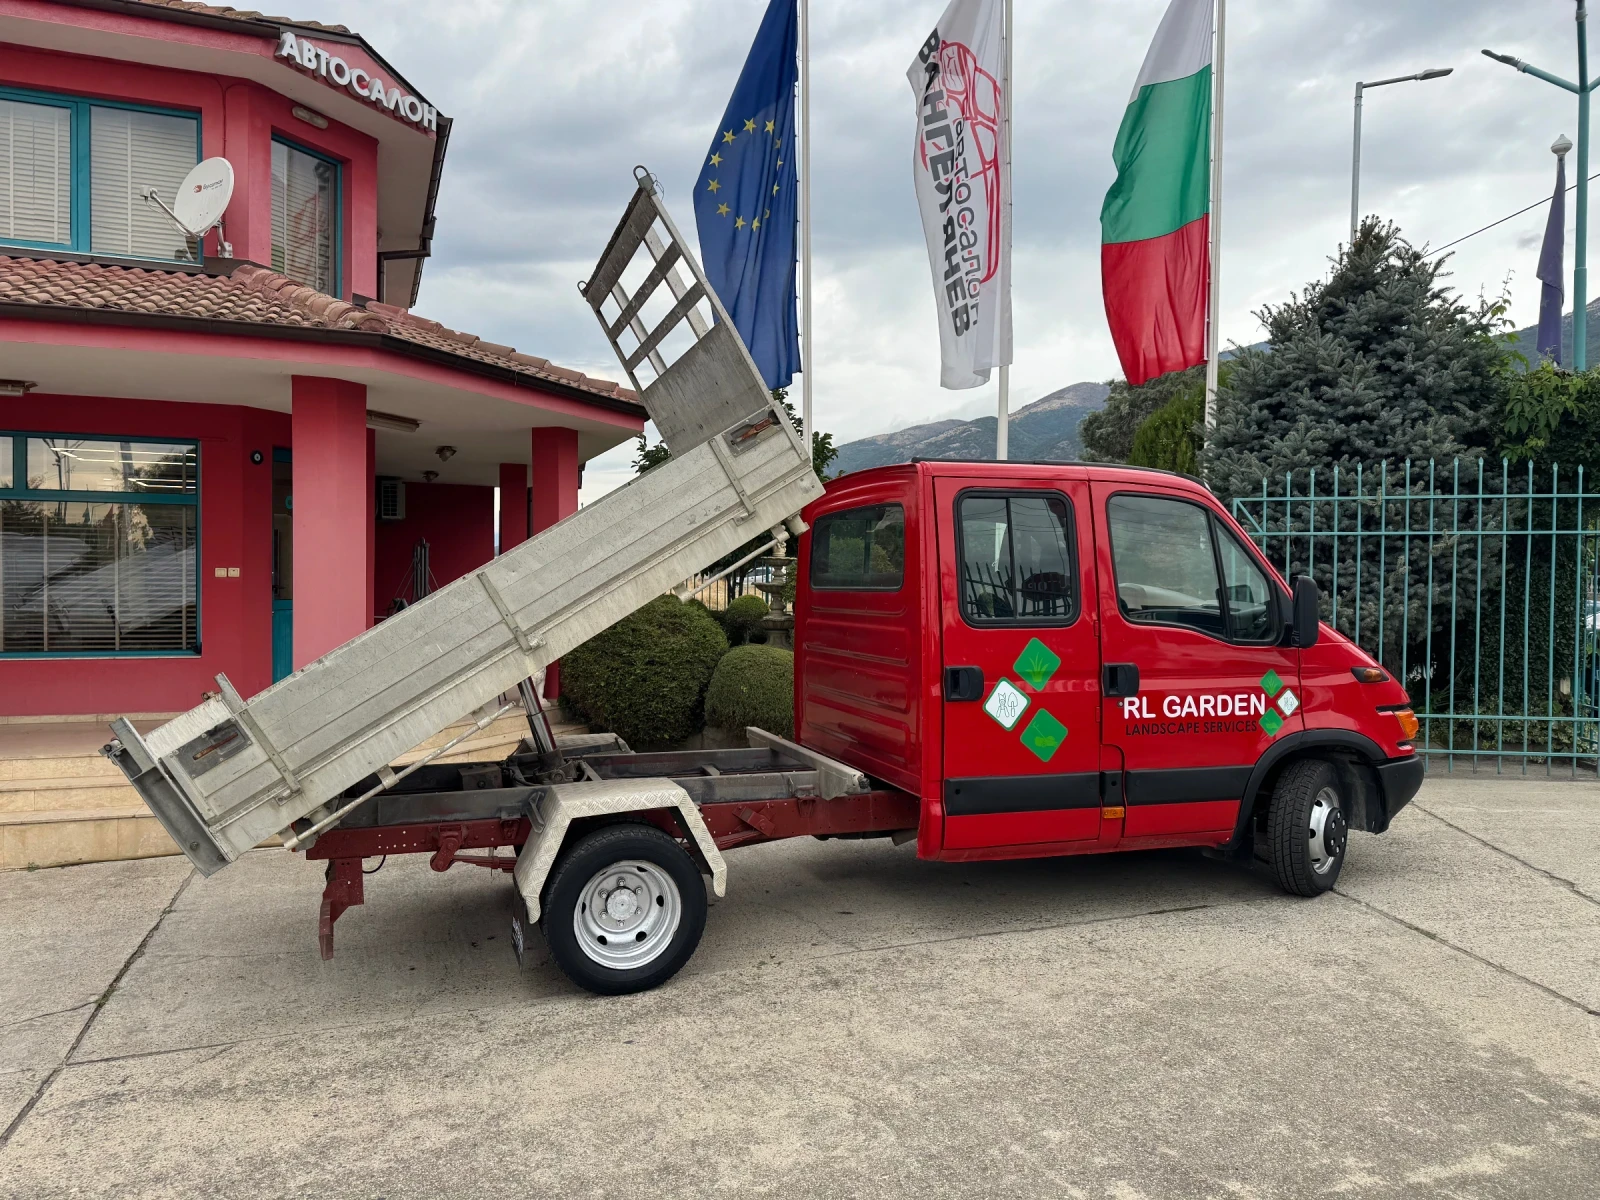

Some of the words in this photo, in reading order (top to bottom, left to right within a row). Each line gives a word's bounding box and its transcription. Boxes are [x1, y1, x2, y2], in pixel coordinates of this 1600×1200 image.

[279, 32, 437, 132] АВТОСАЛОН
[1123, 696, 1156, 719] RL
[1162, 693, 1266, 718] GARDEN
[1125, 721, 1200, 736] LANDSCAPE
[1203, 720, 1258, 734] SERVICES
